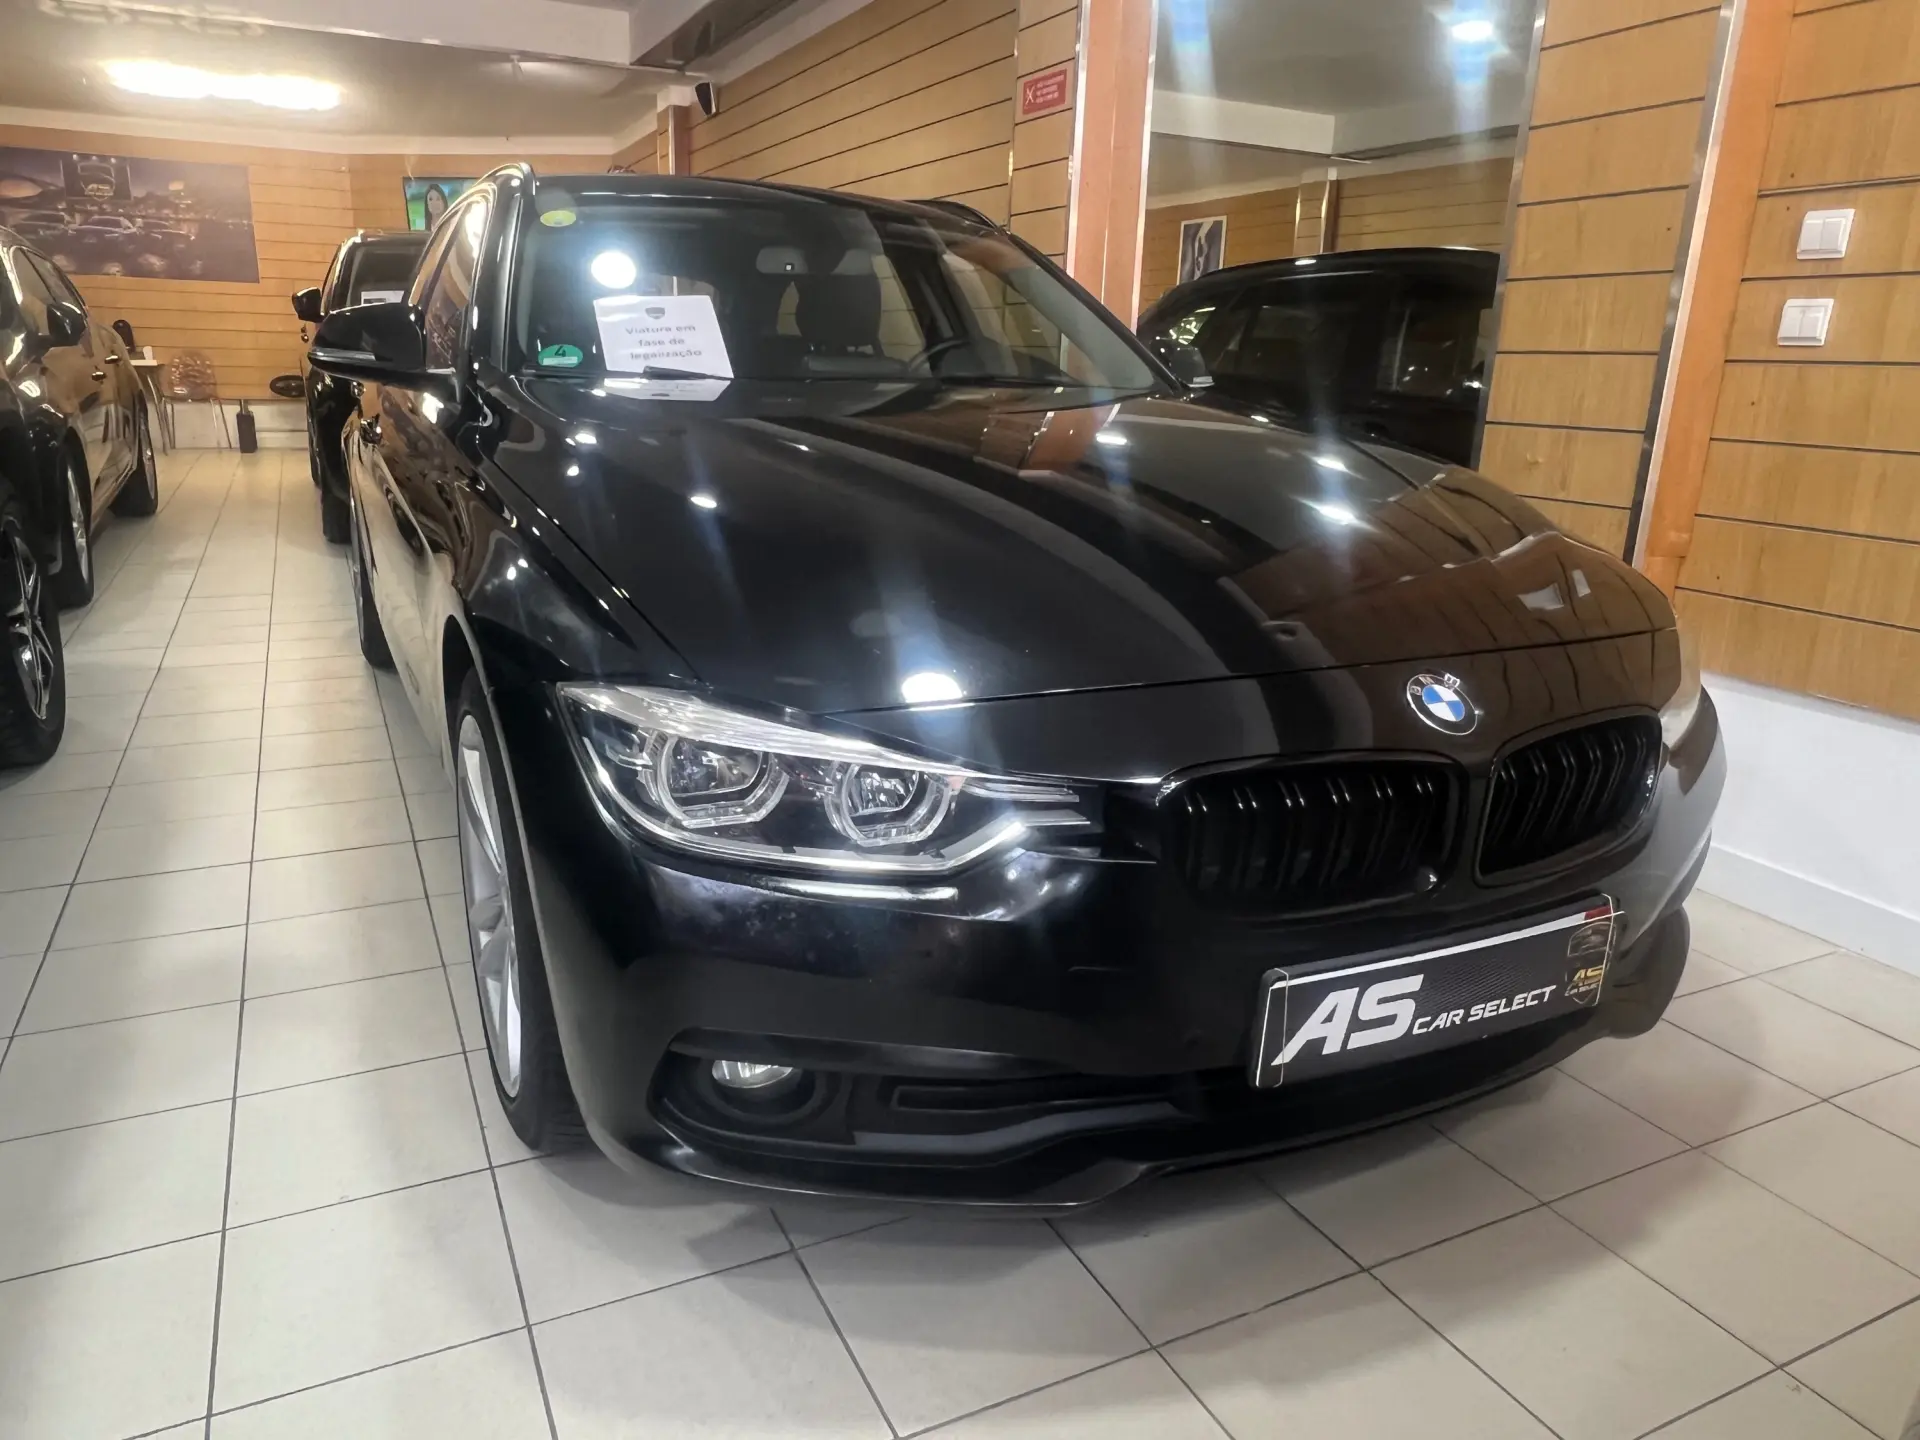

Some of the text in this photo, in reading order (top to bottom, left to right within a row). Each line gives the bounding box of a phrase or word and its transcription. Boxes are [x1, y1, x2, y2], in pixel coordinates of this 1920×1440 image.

[624, 324, 697, 335] Viatura em
[638, 335, 686, 348] fase de
[554, 345, 567, 358] 4
[1271, 973, 1557, 1067] AS CAR SELECT
